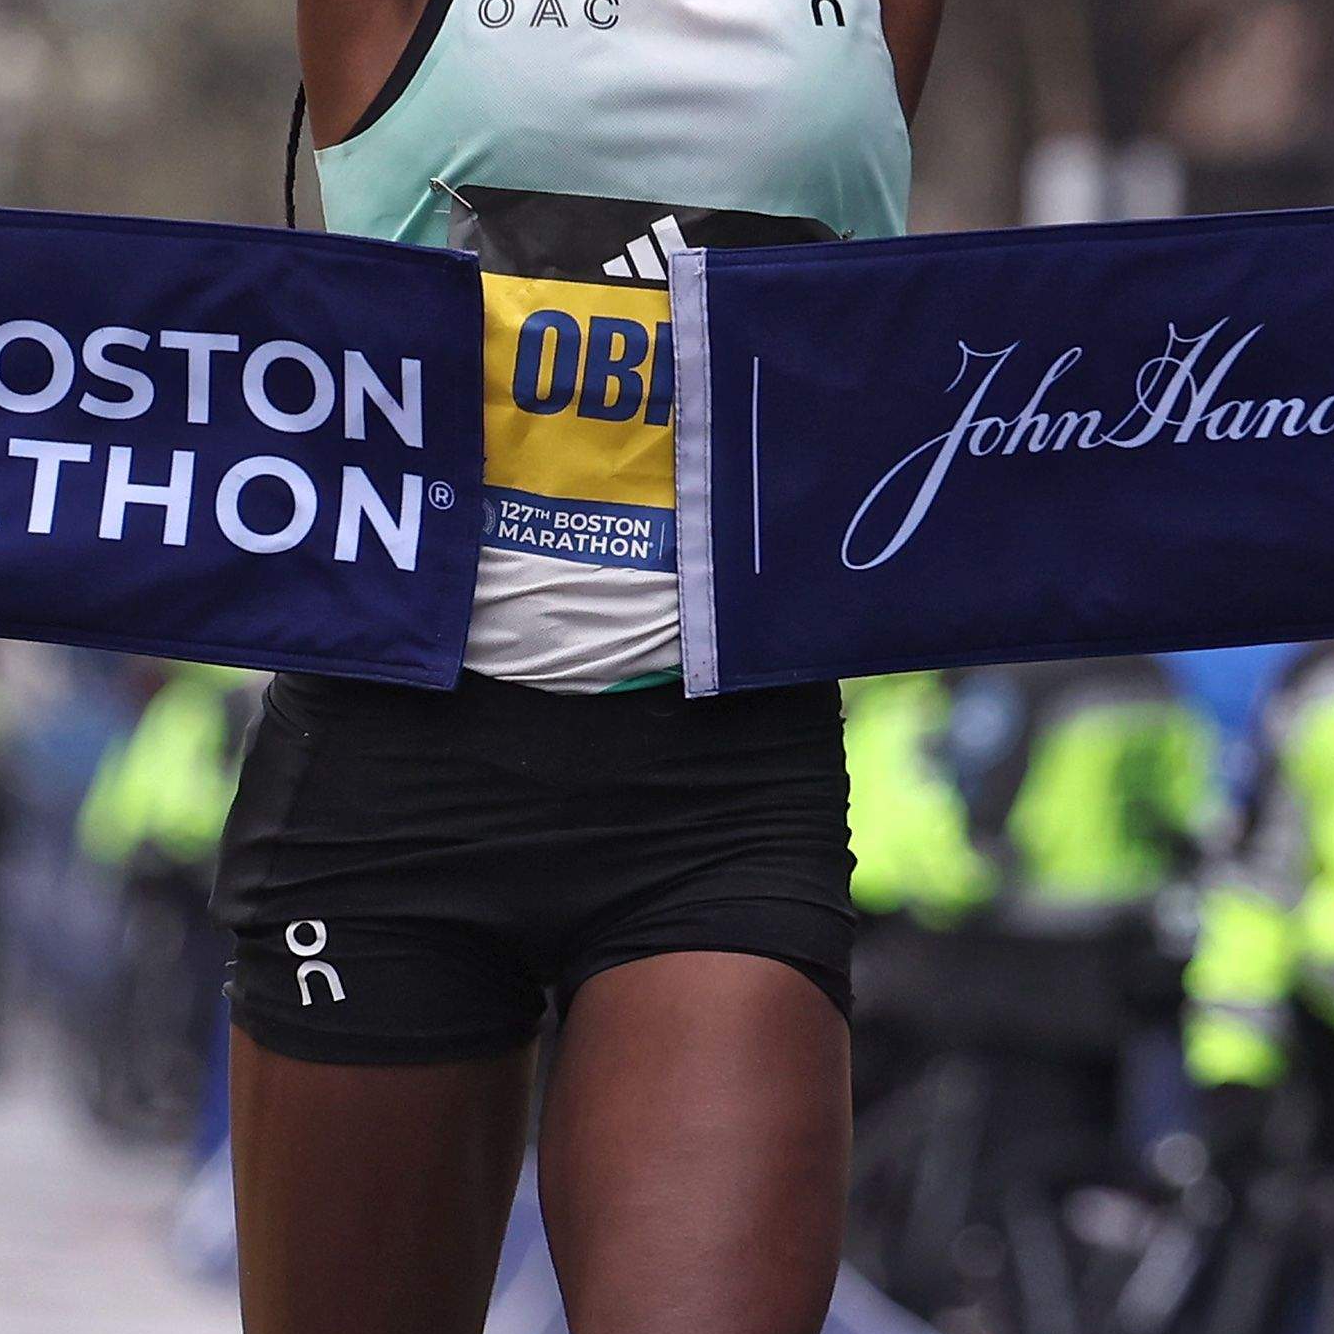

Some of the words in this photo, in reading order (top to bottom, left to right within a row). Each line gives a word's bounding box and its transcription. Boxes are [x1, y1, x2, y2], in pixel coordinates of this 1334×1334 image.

[500, 500, 550, 523] 127TH
[554, 512, 651, 538] BOSTON
[841, 338, 1101, 570] John
